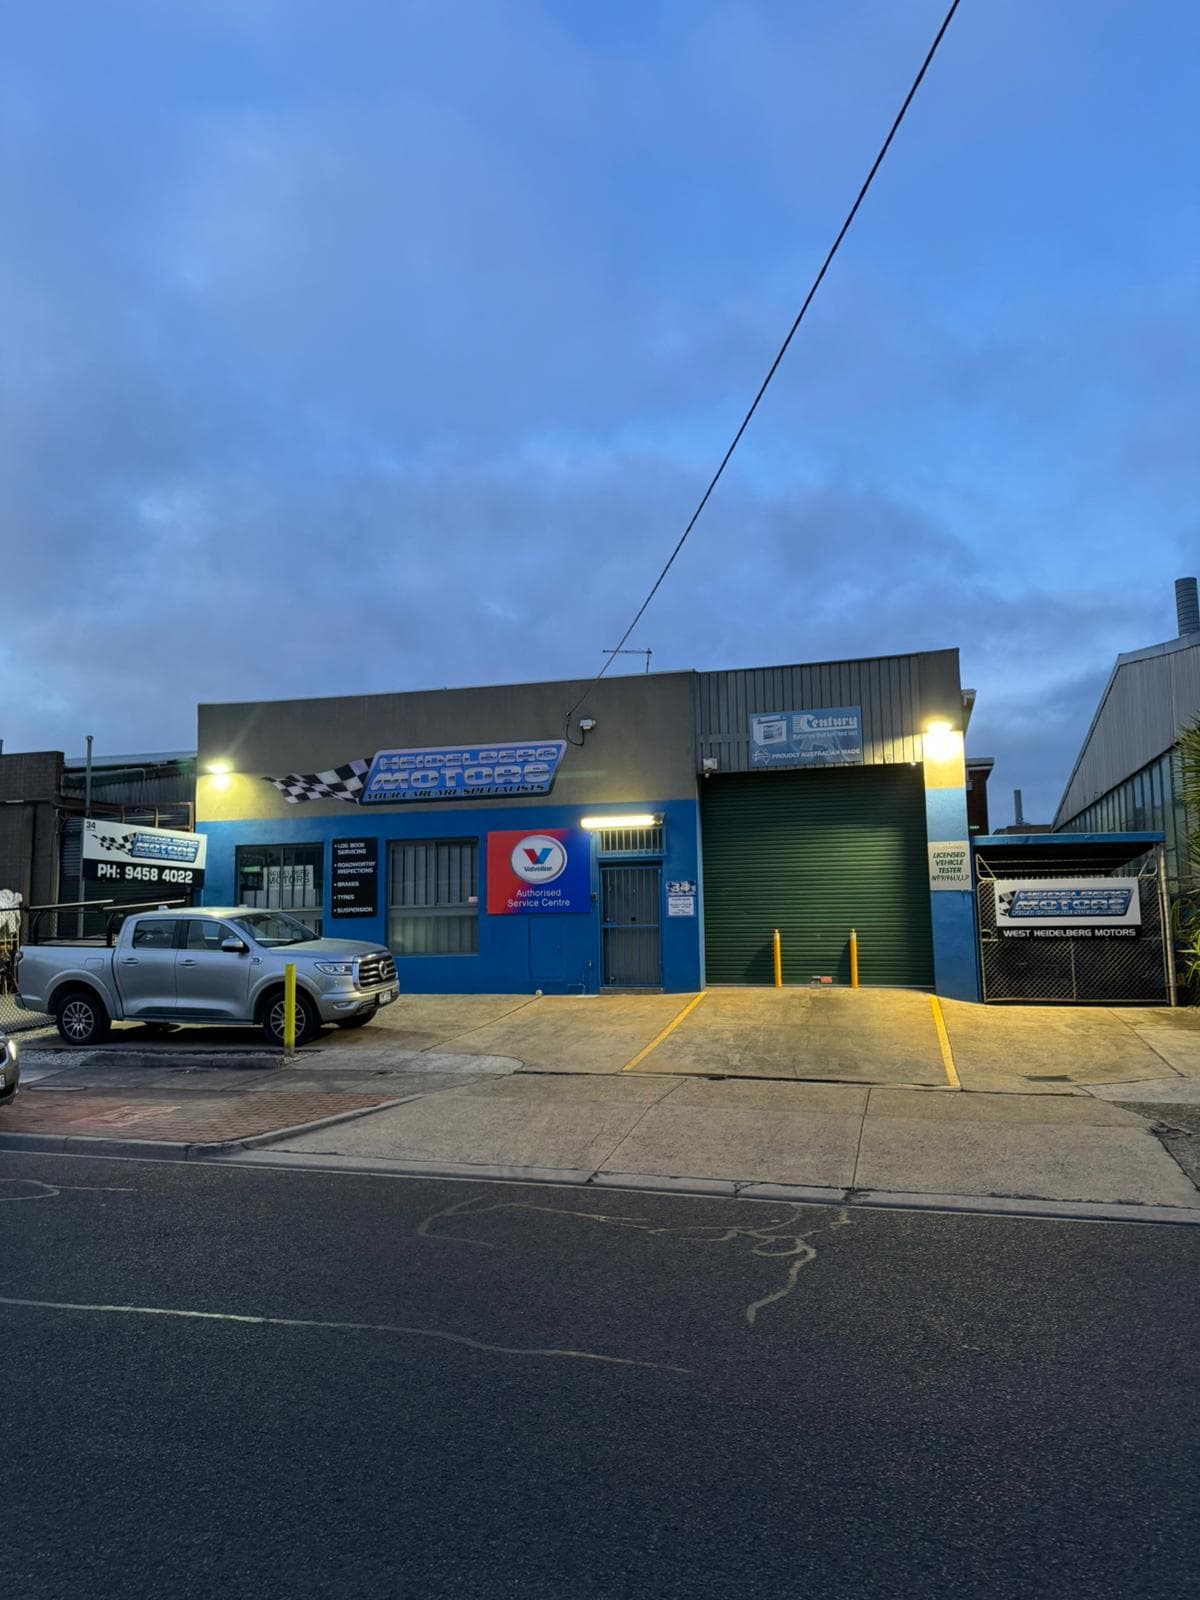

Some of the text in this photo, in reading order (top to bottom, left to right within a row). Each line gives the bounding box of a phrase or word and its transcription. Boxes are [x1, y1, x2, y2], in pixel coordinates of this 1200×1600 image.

[793, 714, 857, 732] Century
[379, 747, 558, 770] HEIDELBERG
[801, 749, 840, 758] AUSTRALIAN
[370, 762, 551, 791] MOTORS
[86, 821, 96, 829] 34
[135, 842, 196, 857] MOTORS
[97, 863, 193, 883] PH: 9458 4022
[337, 867, 374, 875] INSPECTIONS
[516, 889, 561, 898] Authorised
[1018, 890, 1129, 900] HEIDELBERG
[507, 898, 571, 908] Service Centre
[1015, 899, 1125, 911] MOTORS
[1003, 928, 1136, 938] WEST HEIDELBERG MOTORS
